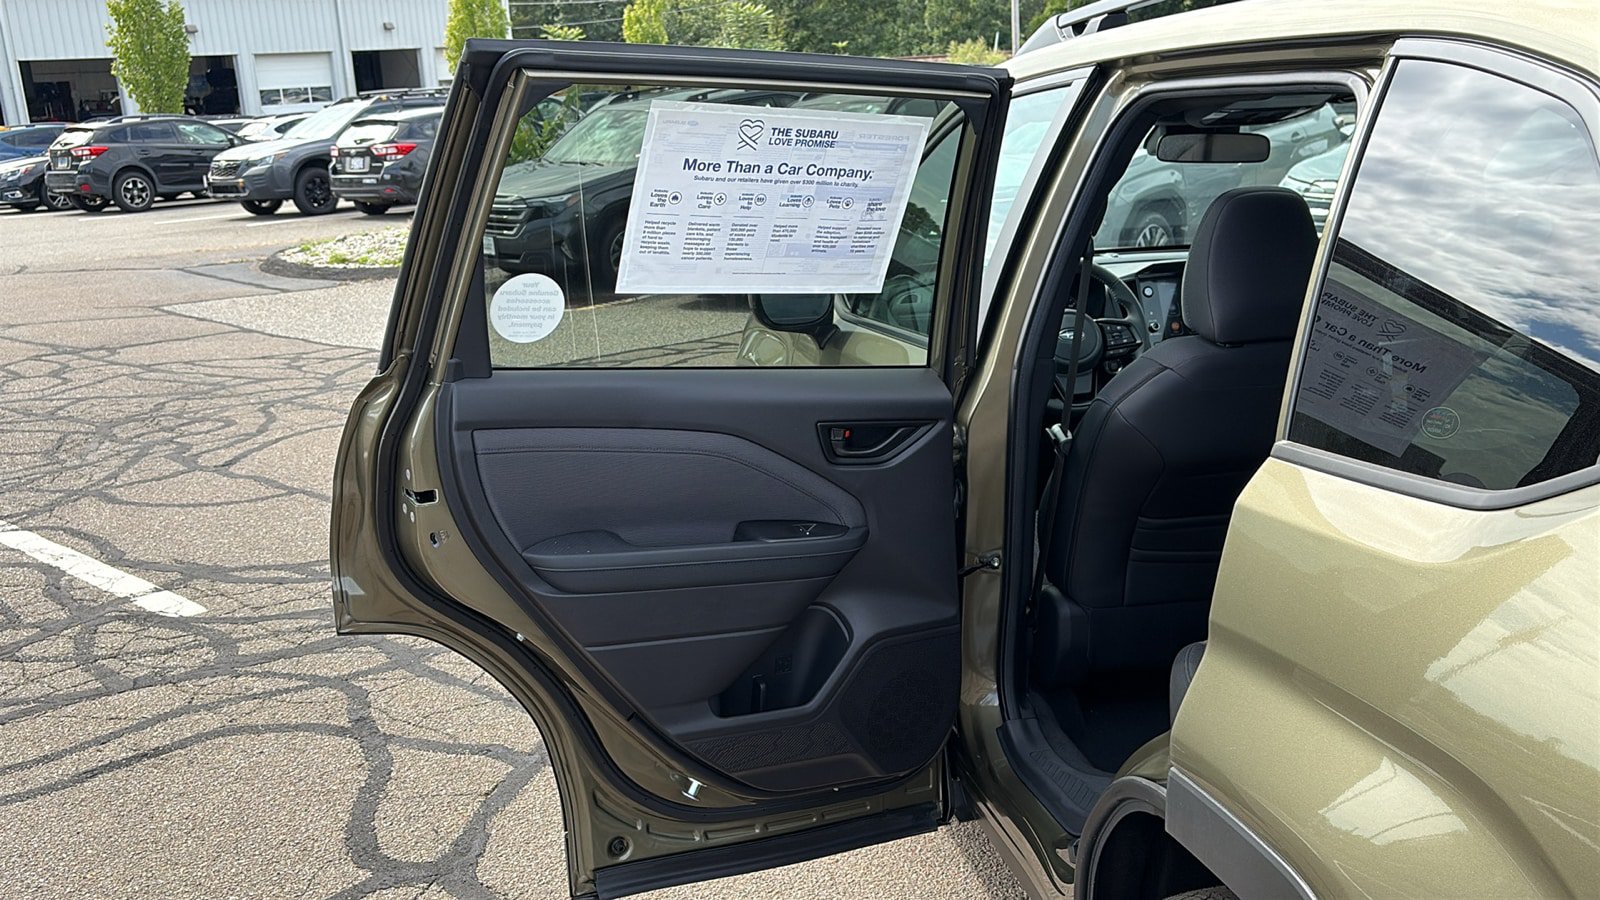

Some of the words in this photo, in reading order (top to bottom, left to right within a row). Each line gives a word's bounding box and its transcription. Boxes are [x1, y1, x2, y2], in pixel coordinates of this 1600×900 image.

[771, 127, 792, 138] THE
[794, 128, 839, 140] SUBARU
[768, 138, 793, 147] LOVE
[794, 139, 836, 149] PROMISE
[682, 158, 722, 173] More
[726, 160, 760, 174] Than
[764, 164, 773, 174] a
[778, 162, 803, 176] Car
